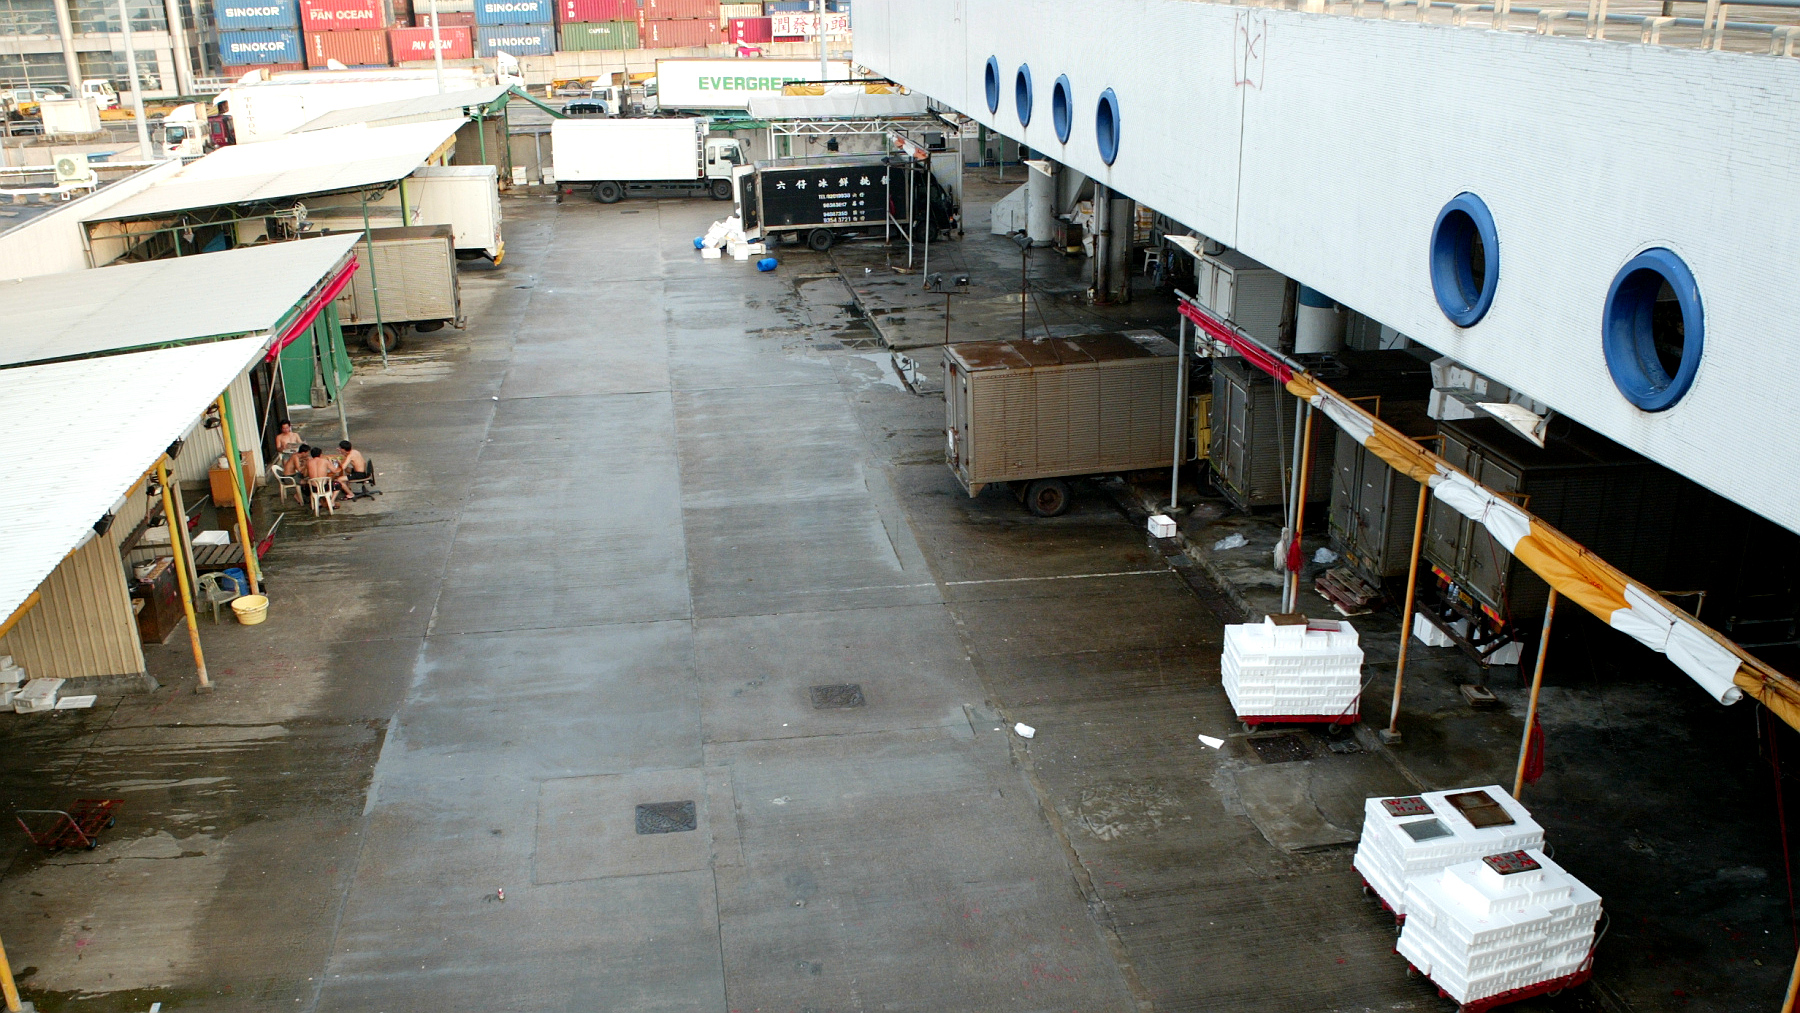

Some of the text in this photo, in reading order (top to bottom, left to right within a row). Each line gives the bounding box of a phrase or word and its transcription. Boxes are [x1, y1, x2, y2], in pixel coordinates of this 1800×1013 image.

[225, 7, 280, 17] SINOKOR
[485, 3, 538, 13] SINOKOR
[310, 10, 373, 20] PAN OCEAN
[231, 42, 285, 52] SINOKOR
[412, 40, 453, 50] PAN OEAN
[488, 37, 541, 47] SINOKOR
